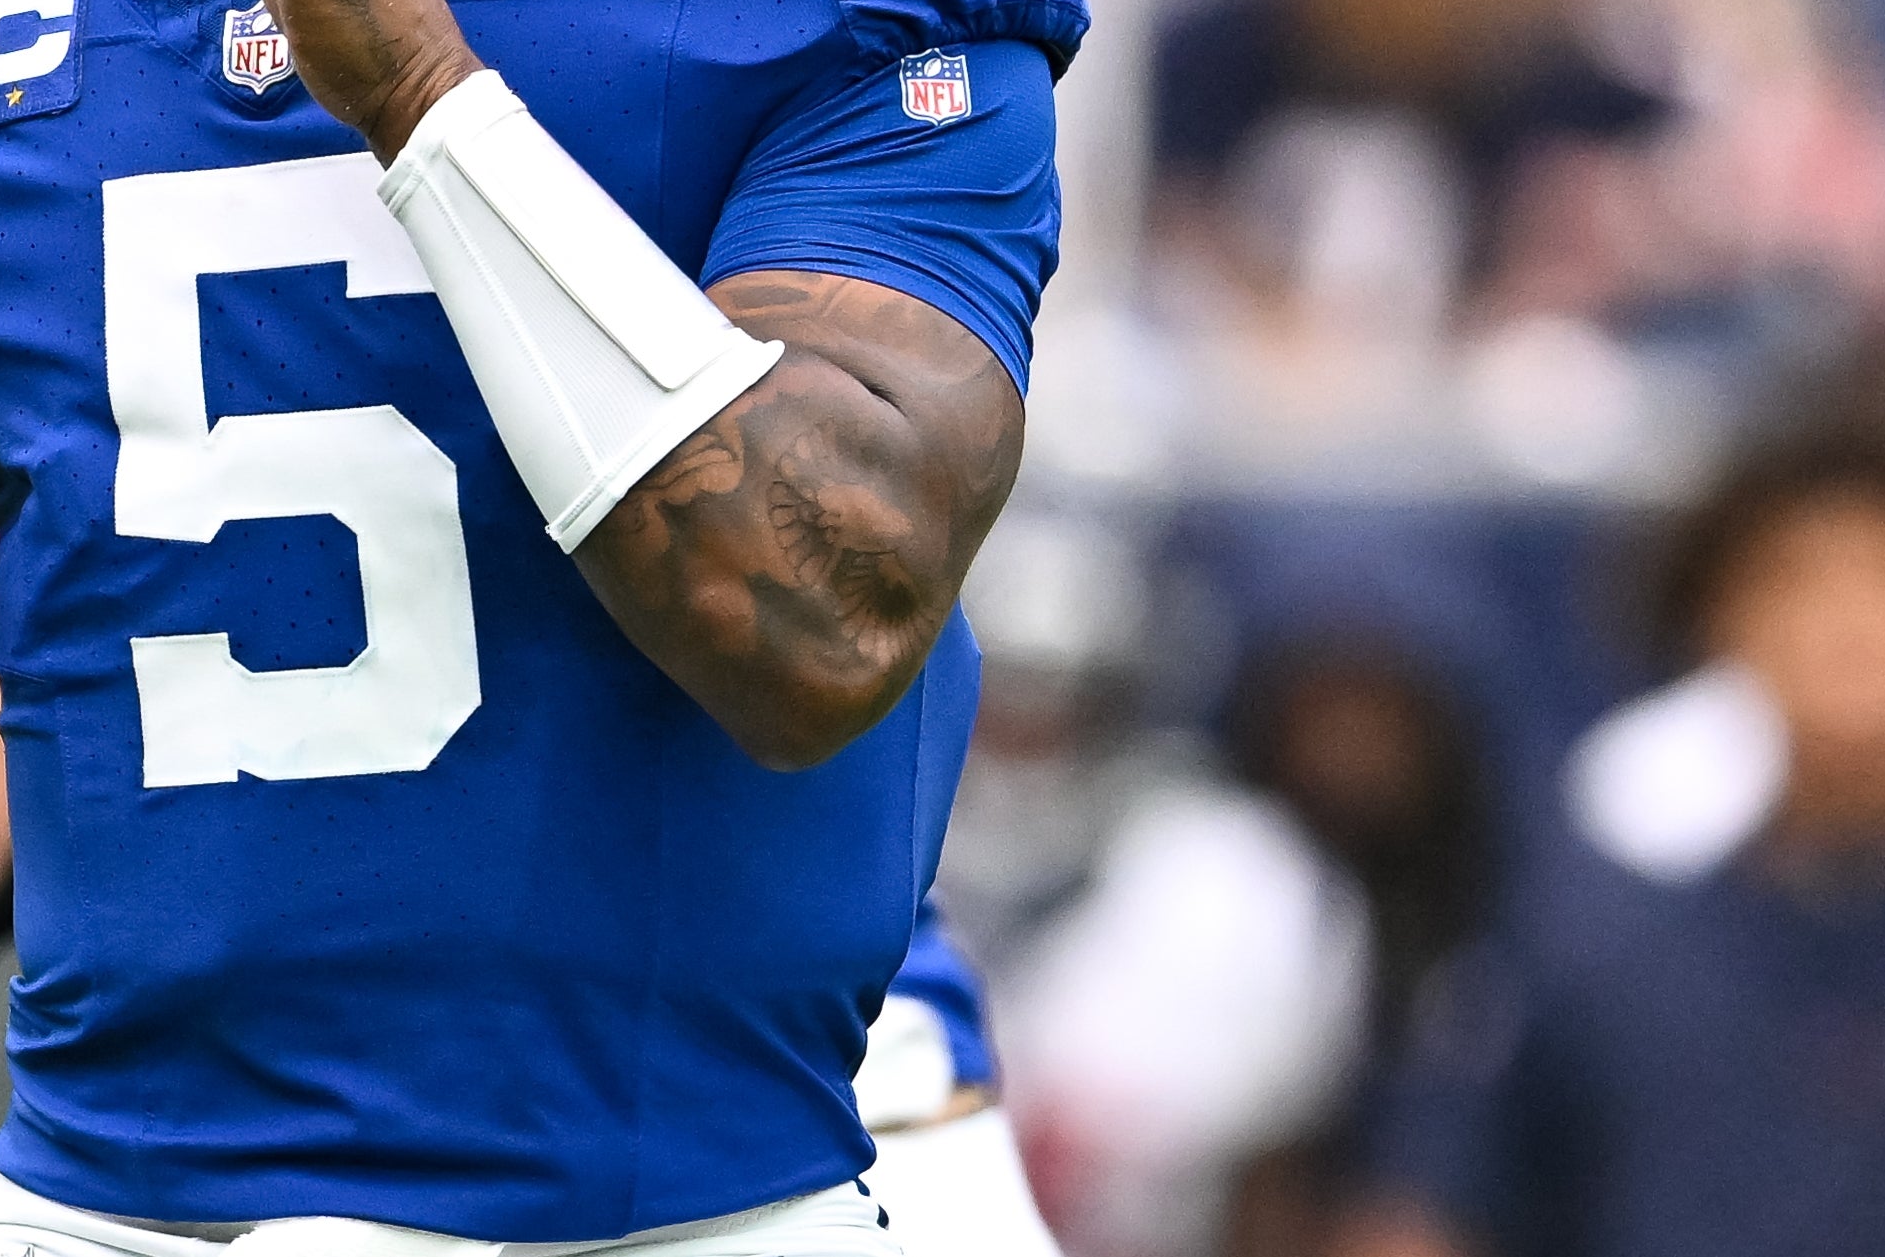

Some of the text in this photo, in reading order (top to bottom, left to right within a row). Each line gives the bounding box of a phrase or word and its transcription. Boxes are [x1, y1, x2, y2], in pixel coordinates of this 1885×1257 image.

[235, 39, 284, 75] NFL
[910, 81, 963, 115] NFL
[102, 151, 482, 788] 5
